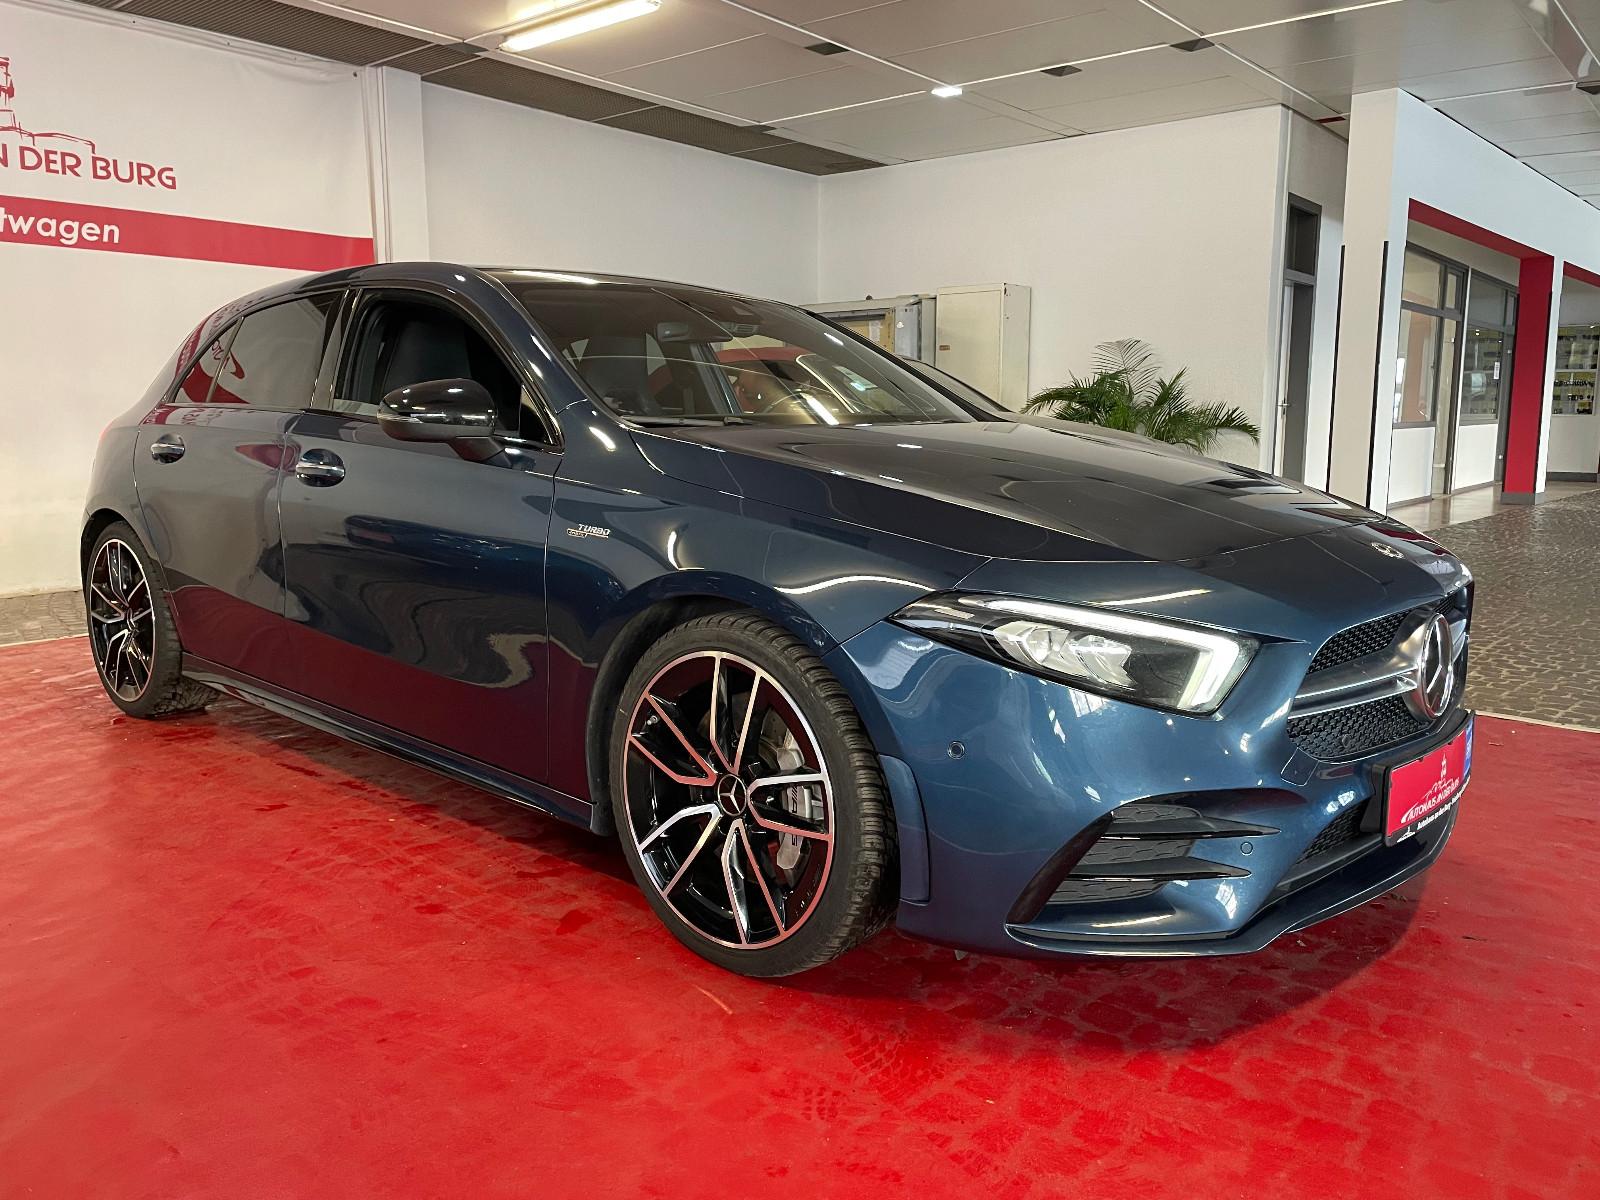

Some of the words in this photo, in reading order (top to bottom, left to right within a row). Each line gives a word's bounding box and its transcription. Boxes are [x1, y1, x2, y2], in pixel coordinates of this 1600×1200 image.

[19, 145, 82, 177] DER
[92, 154, 177, 190] BURG
[578, 523, 611, 536] TURBO
